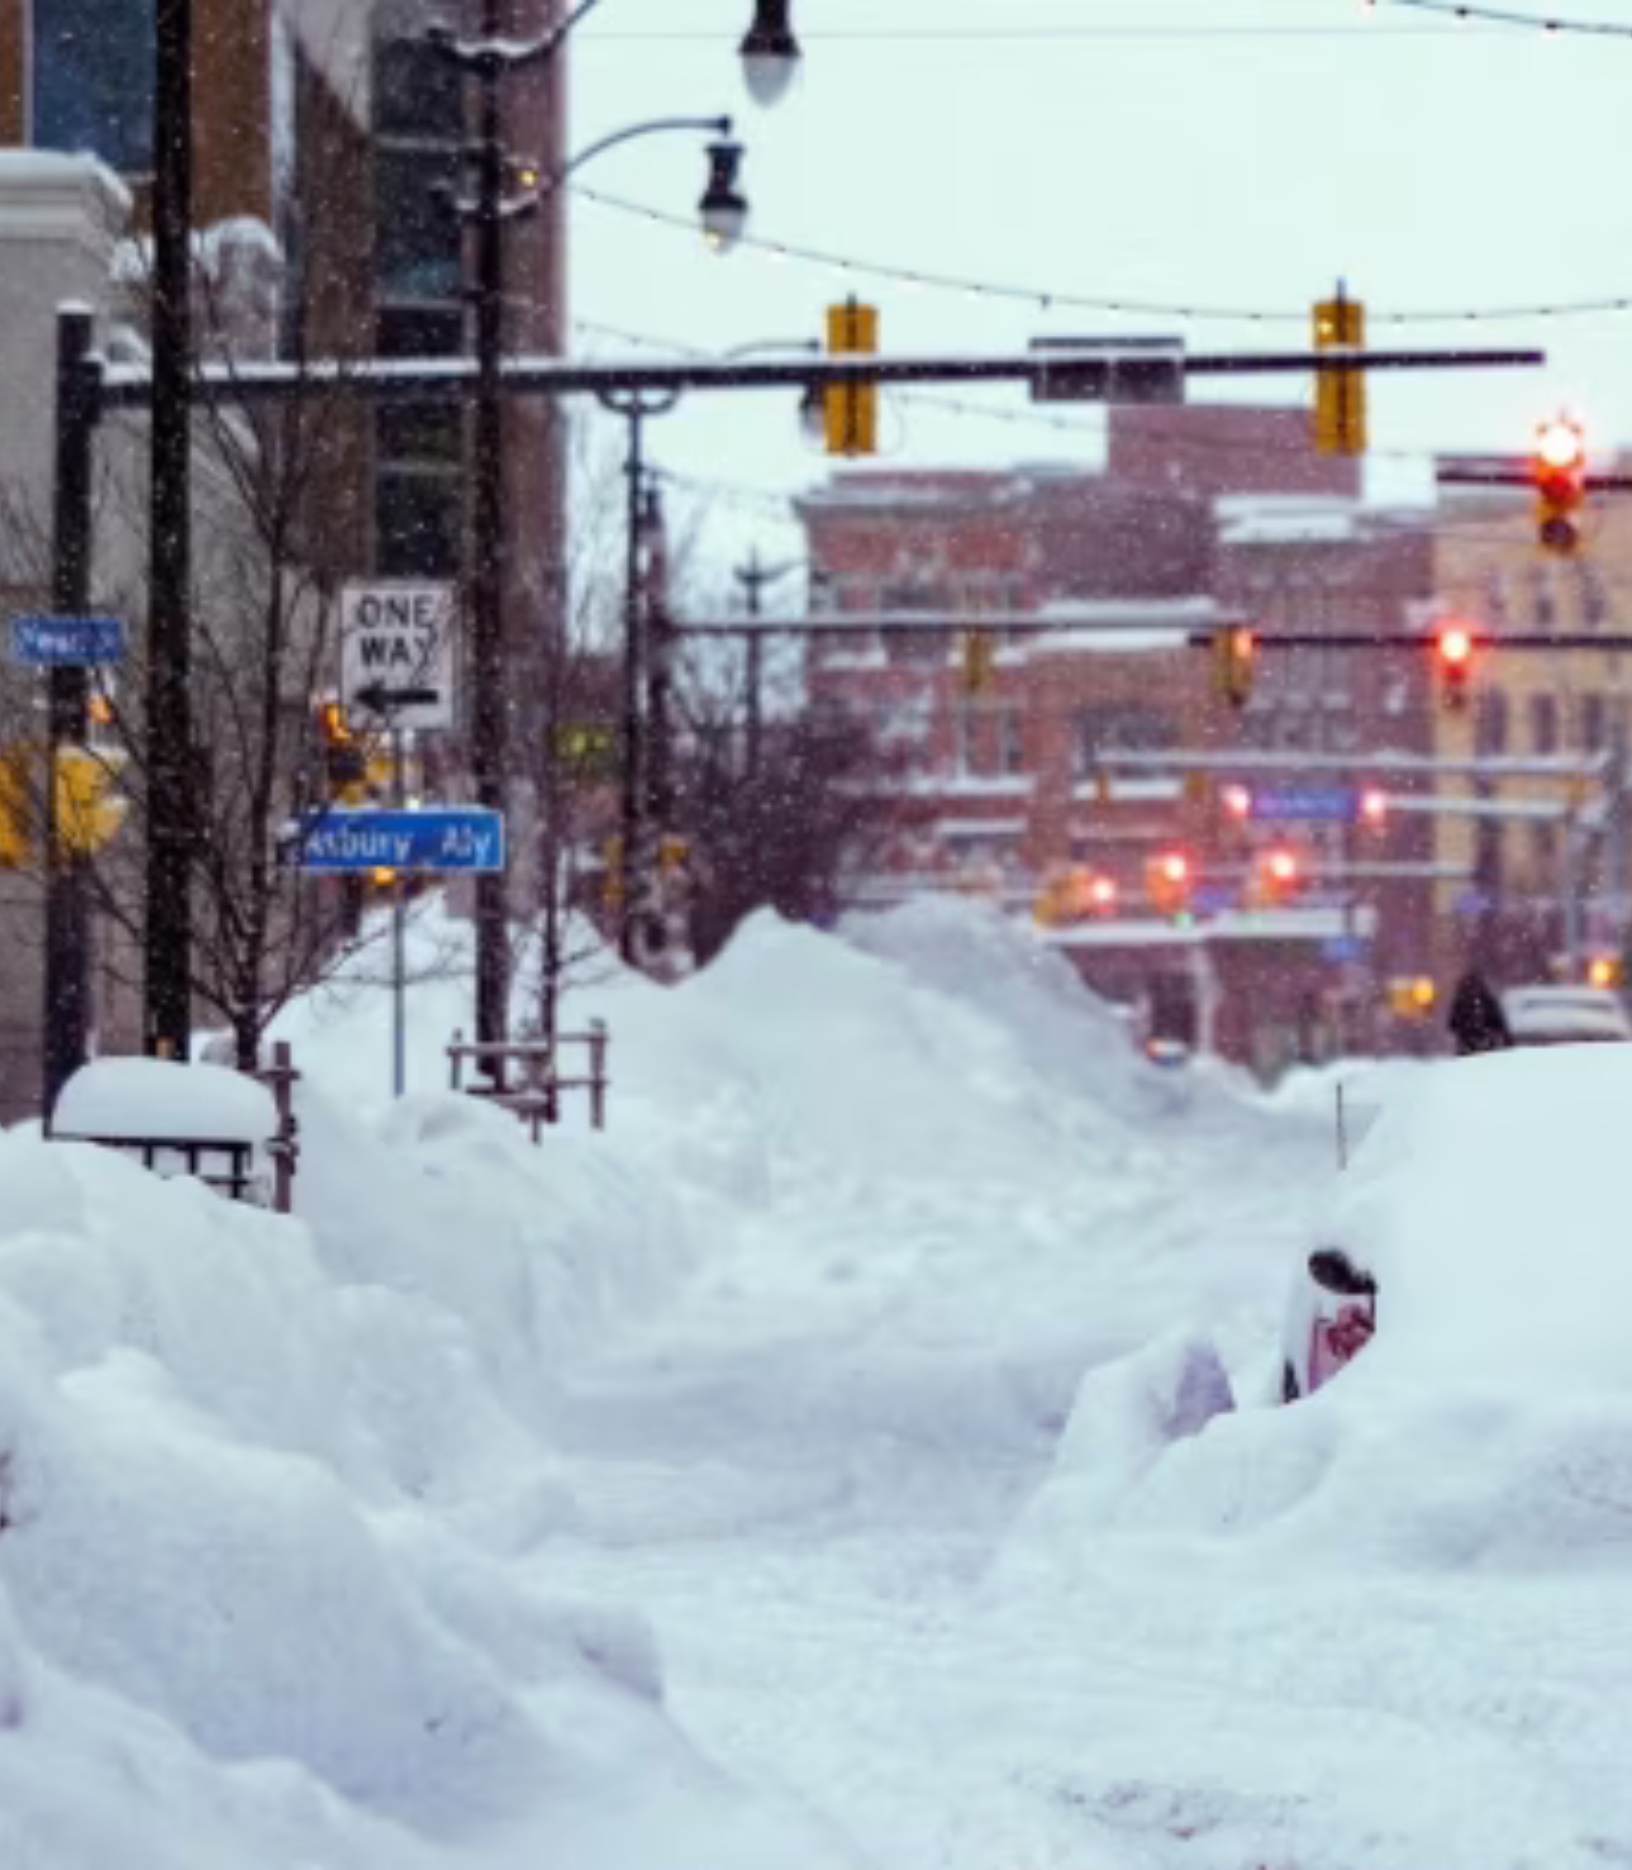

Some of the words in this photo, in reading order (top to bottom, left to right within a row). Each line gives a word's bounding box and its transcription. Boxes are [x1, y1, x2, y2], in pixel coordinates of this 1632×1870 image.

[357, 593, 434, 629] ONE
[360, 634, 437, 668] WAY
[306, 824, 414, 863] Asbury
